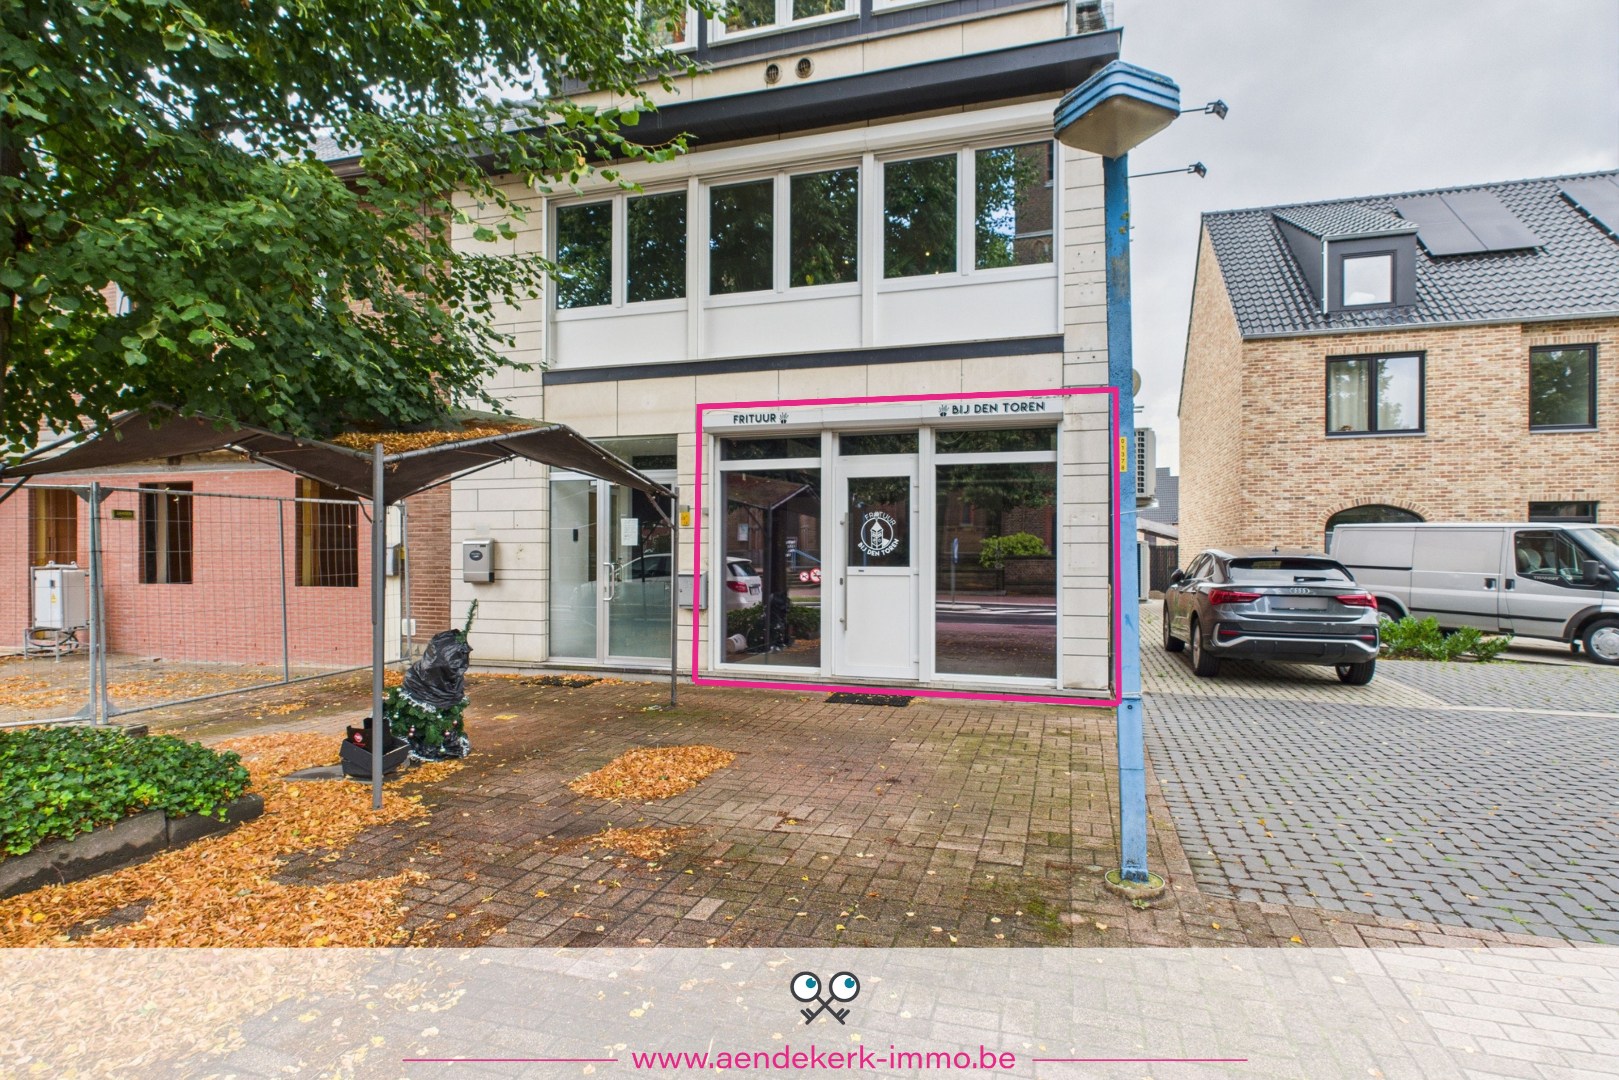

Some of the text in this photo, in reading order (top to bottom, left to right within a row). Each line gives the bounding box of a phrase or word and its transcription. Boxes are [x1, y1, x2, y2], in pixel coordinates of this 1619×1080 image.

[952, 401, 1046, 415] BIJ DEN TOREN
[733, 413, 777, 425] FRITUUR
[864, 511, 897, 526] FRTUUR
[866, 549, 880, 557] DEN
[880, 538, 900, 556] TOREN
